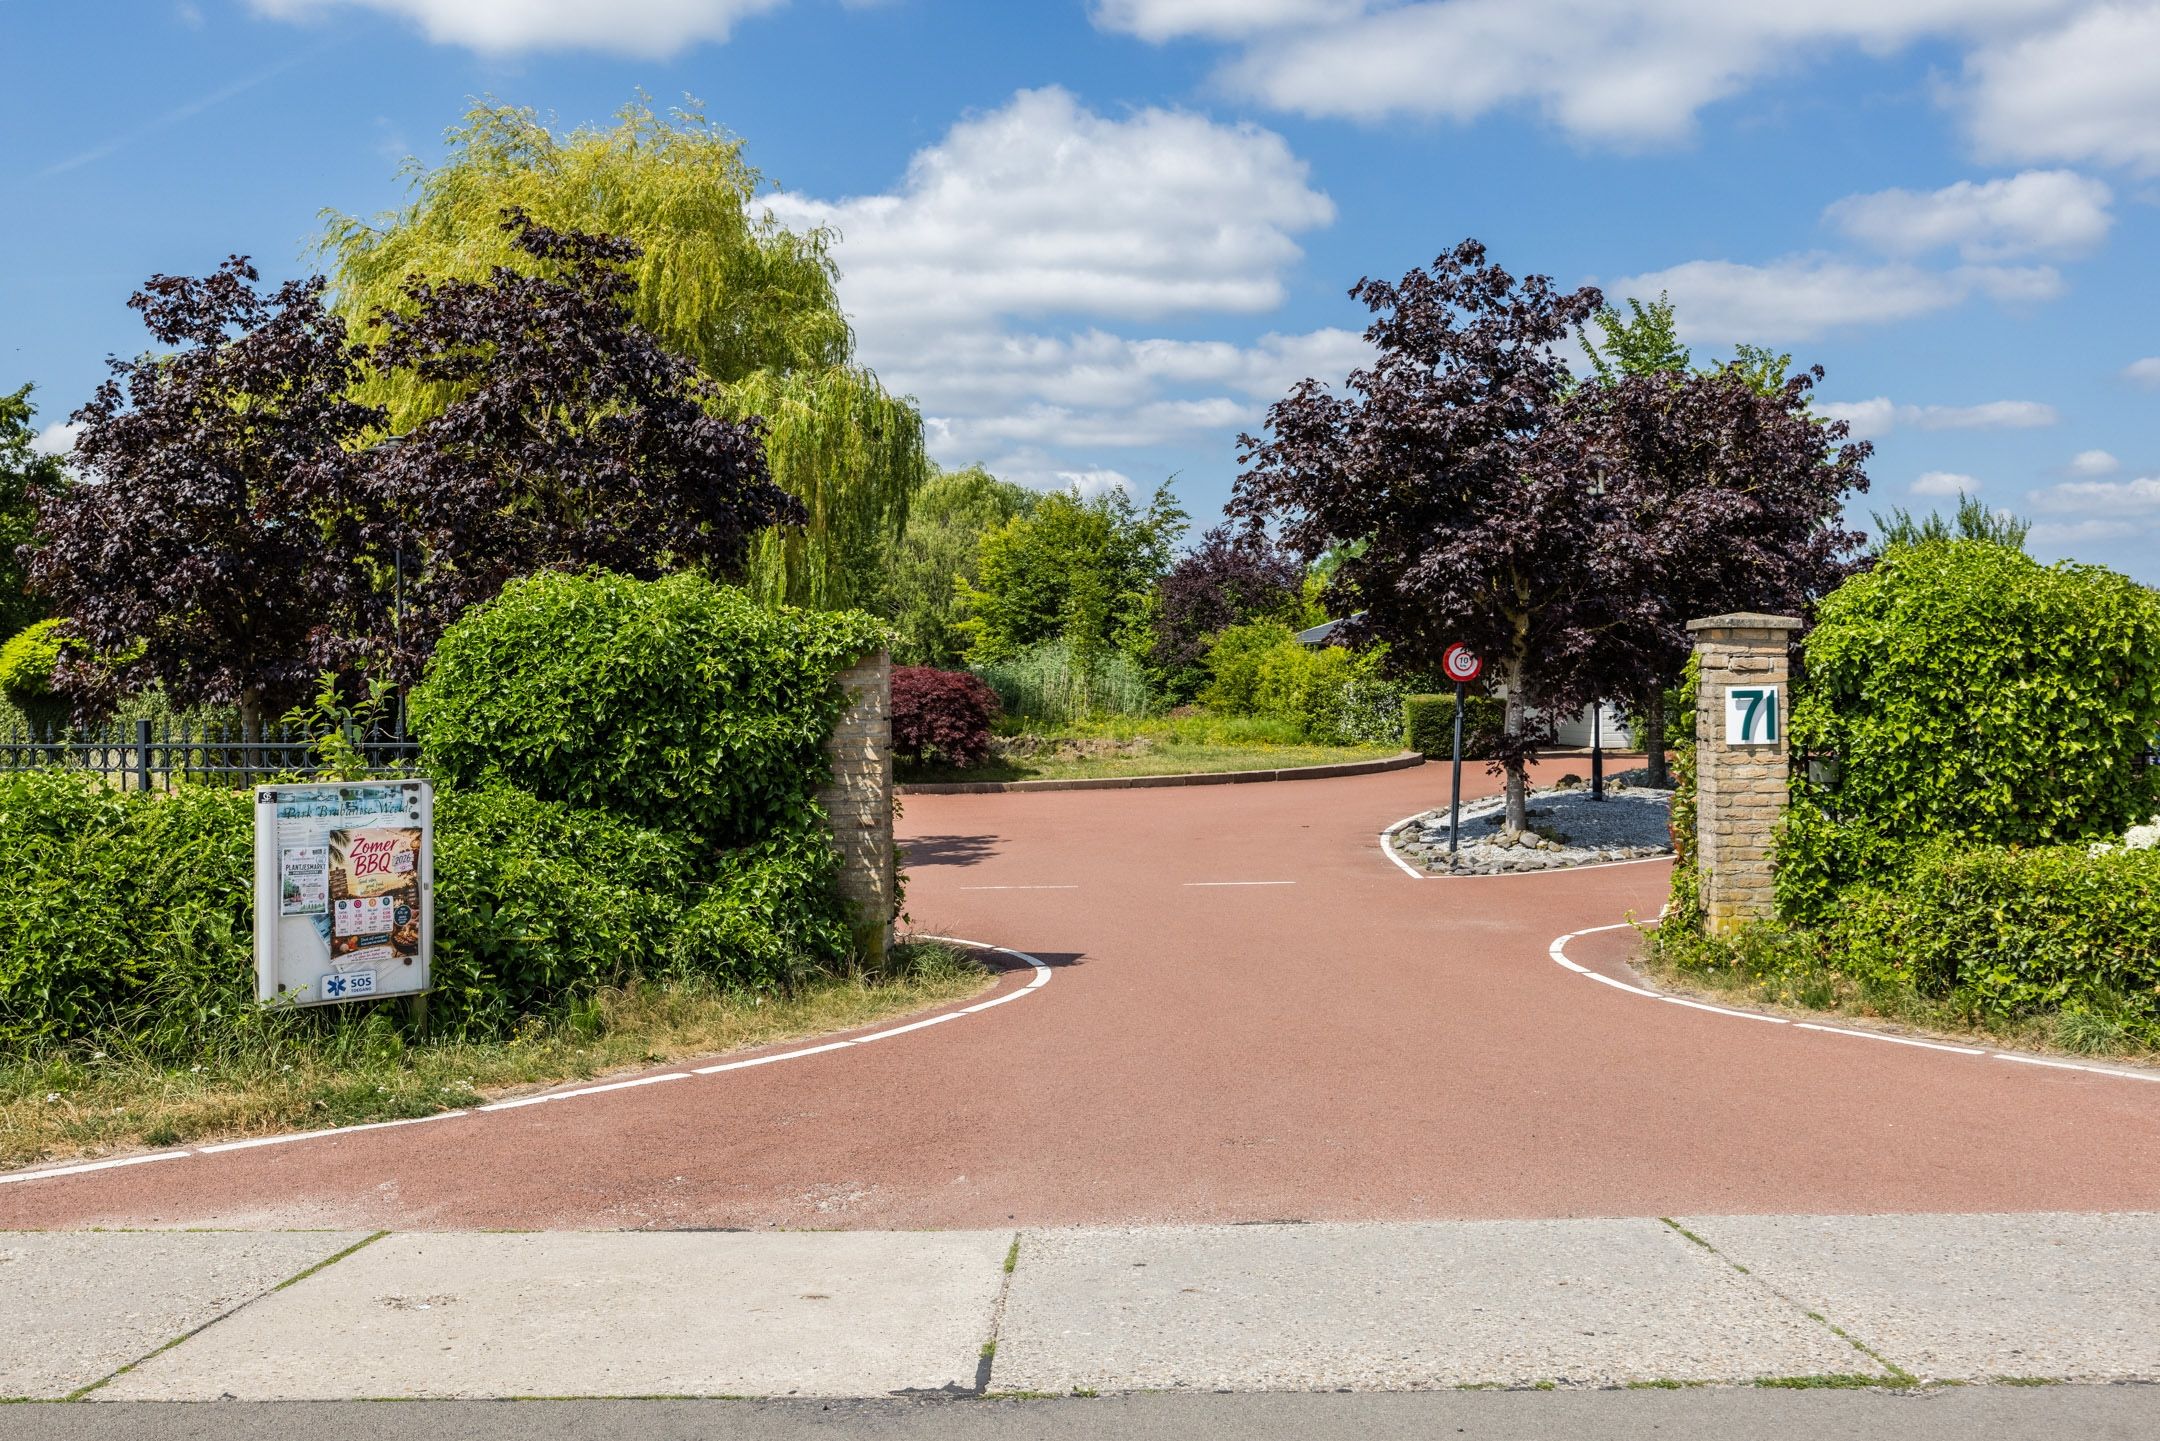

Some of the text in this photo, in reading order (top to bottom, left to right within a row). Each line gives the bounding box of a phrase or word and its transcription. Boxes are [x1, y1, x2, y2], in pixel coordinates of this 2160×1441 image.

[1731, 689, 1775, 741] 71
[283, 804, 312, 819] Park
[350, 837, 399, 858] Zomer
[354, 852, 392, 876] BBQ
[395, 854, 411, 865] 2026
[285, 863, 326, 872] PLANTJESMARKT
[351, 977, 372, 988] SOS
